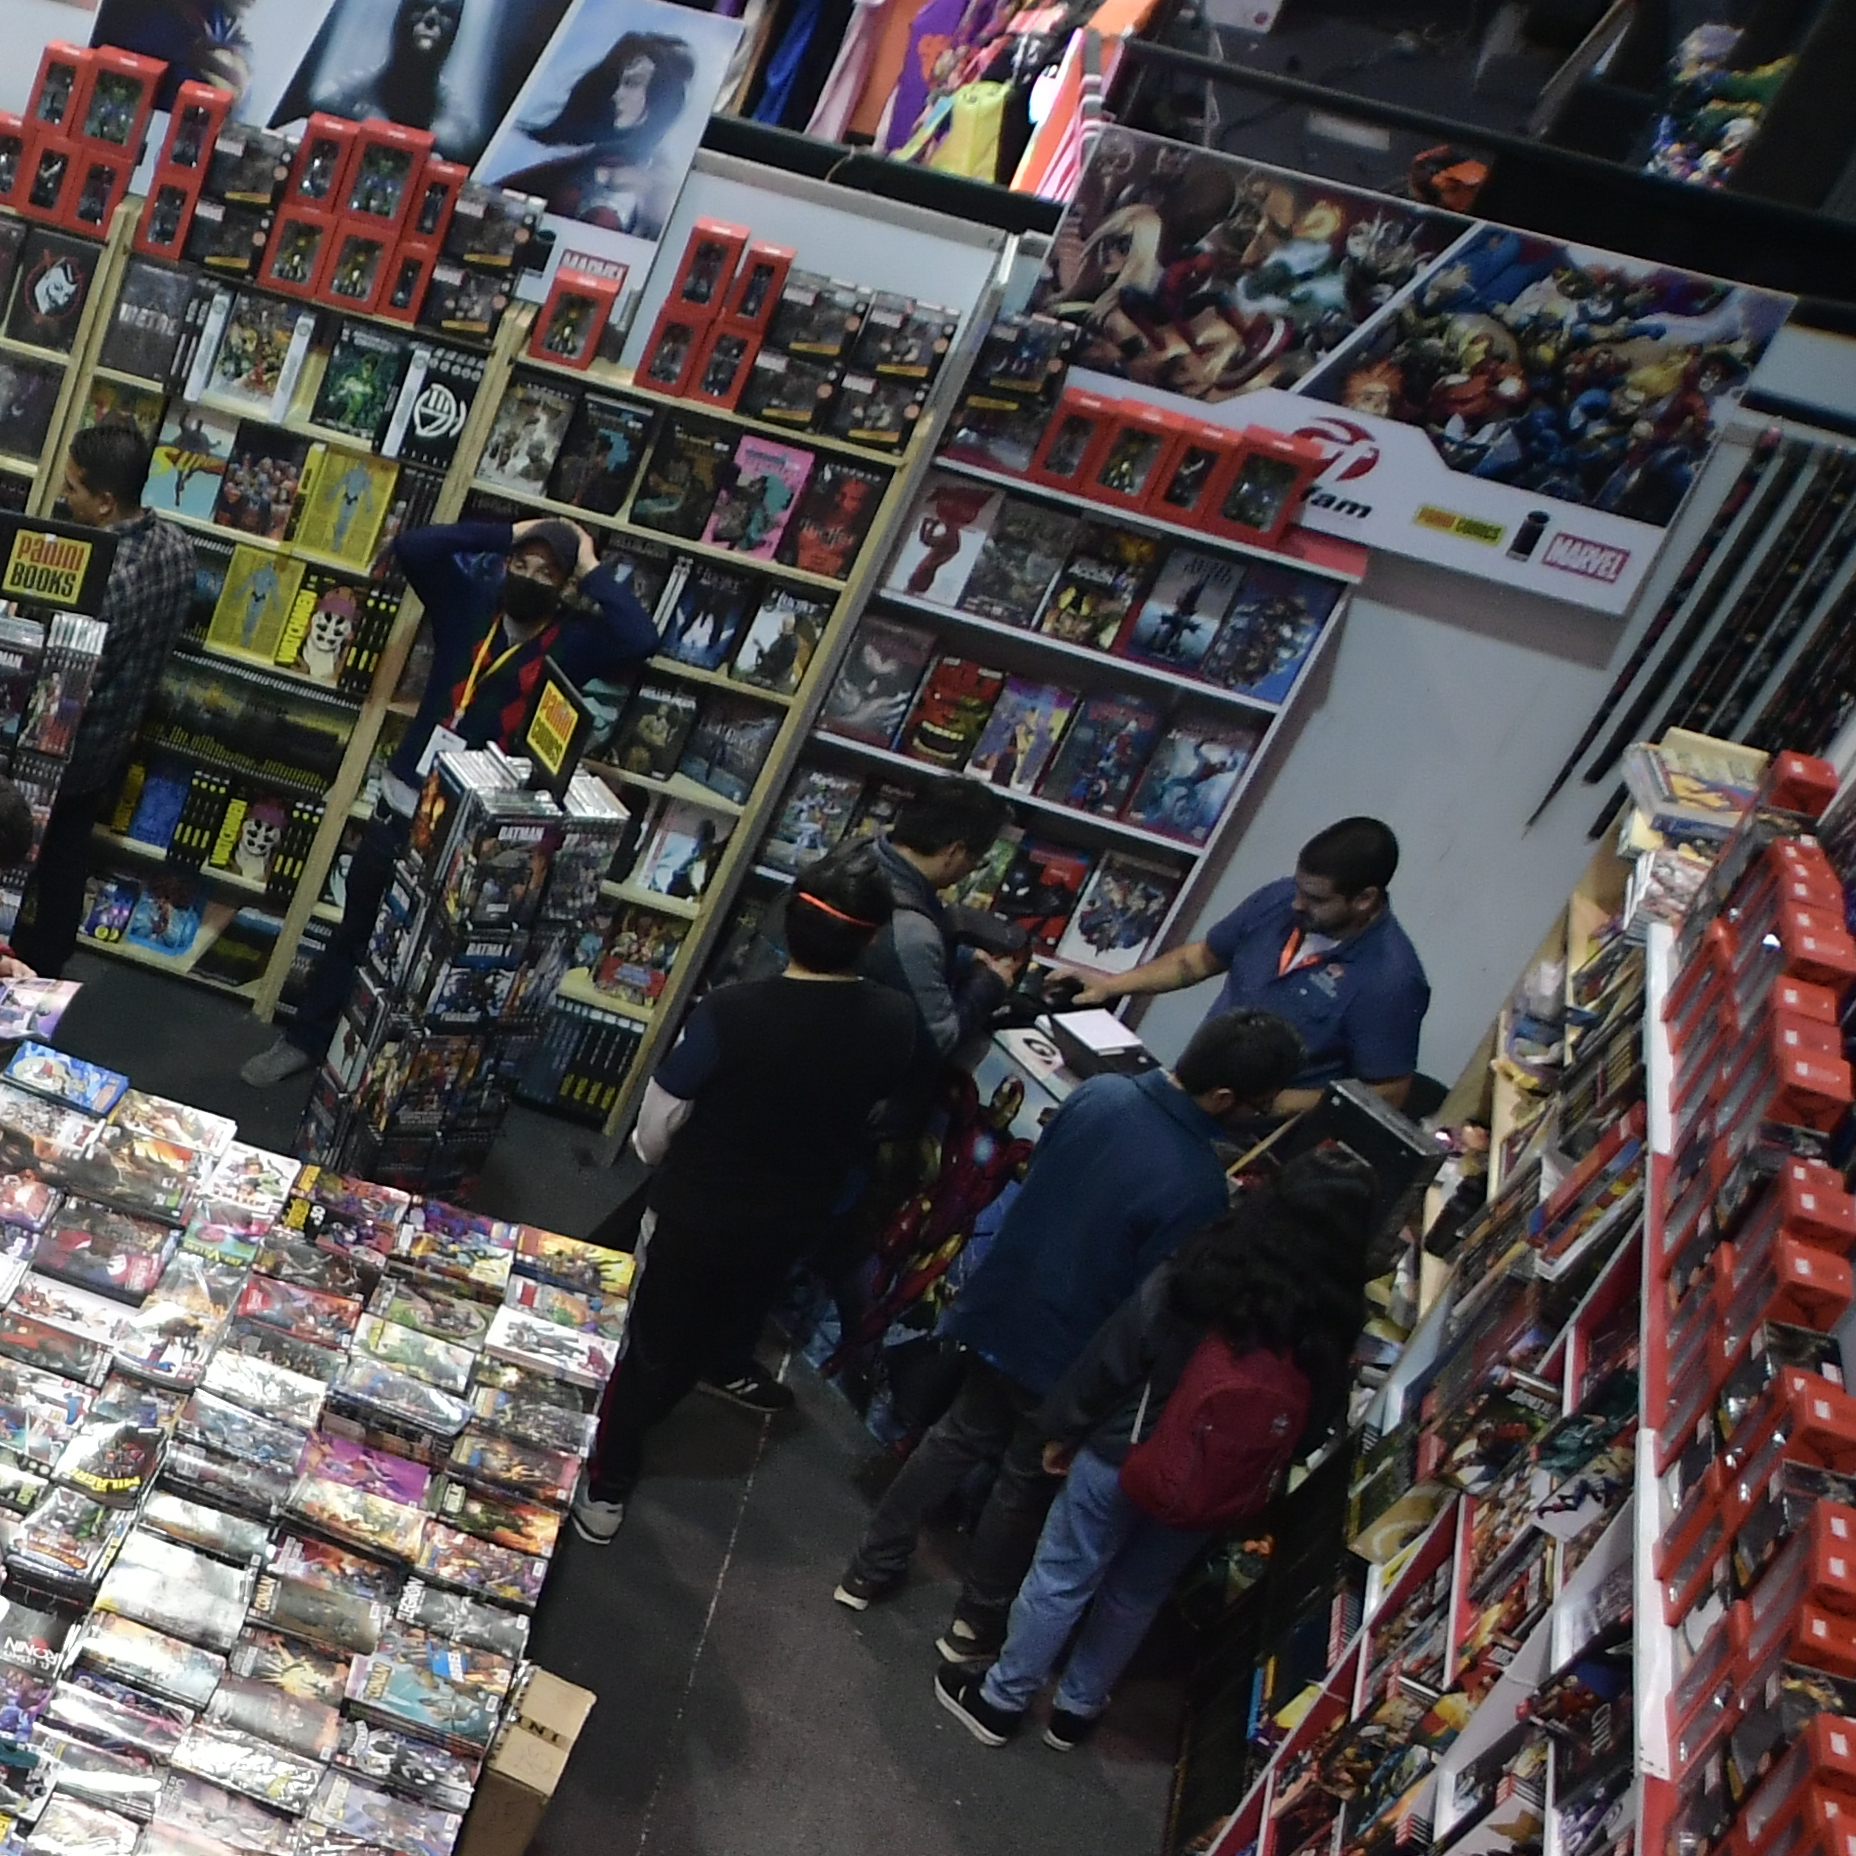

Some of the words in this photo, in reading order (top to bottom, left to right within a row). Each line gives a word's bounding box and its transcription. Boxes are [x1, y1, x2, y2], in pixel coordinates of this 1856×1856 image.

[17, 534, 85, 571] panini
[1547, 535, 1623, 579] MARVEL
[10, 564, 76, 597] BOOKS
[275, 589, 317, 664] WATCHMEN
[209, 798, 248, 866] WATCHMEN
[498, 825, 544, 842] BATMAN
[3, 1636, 61, 1666] RONIN
